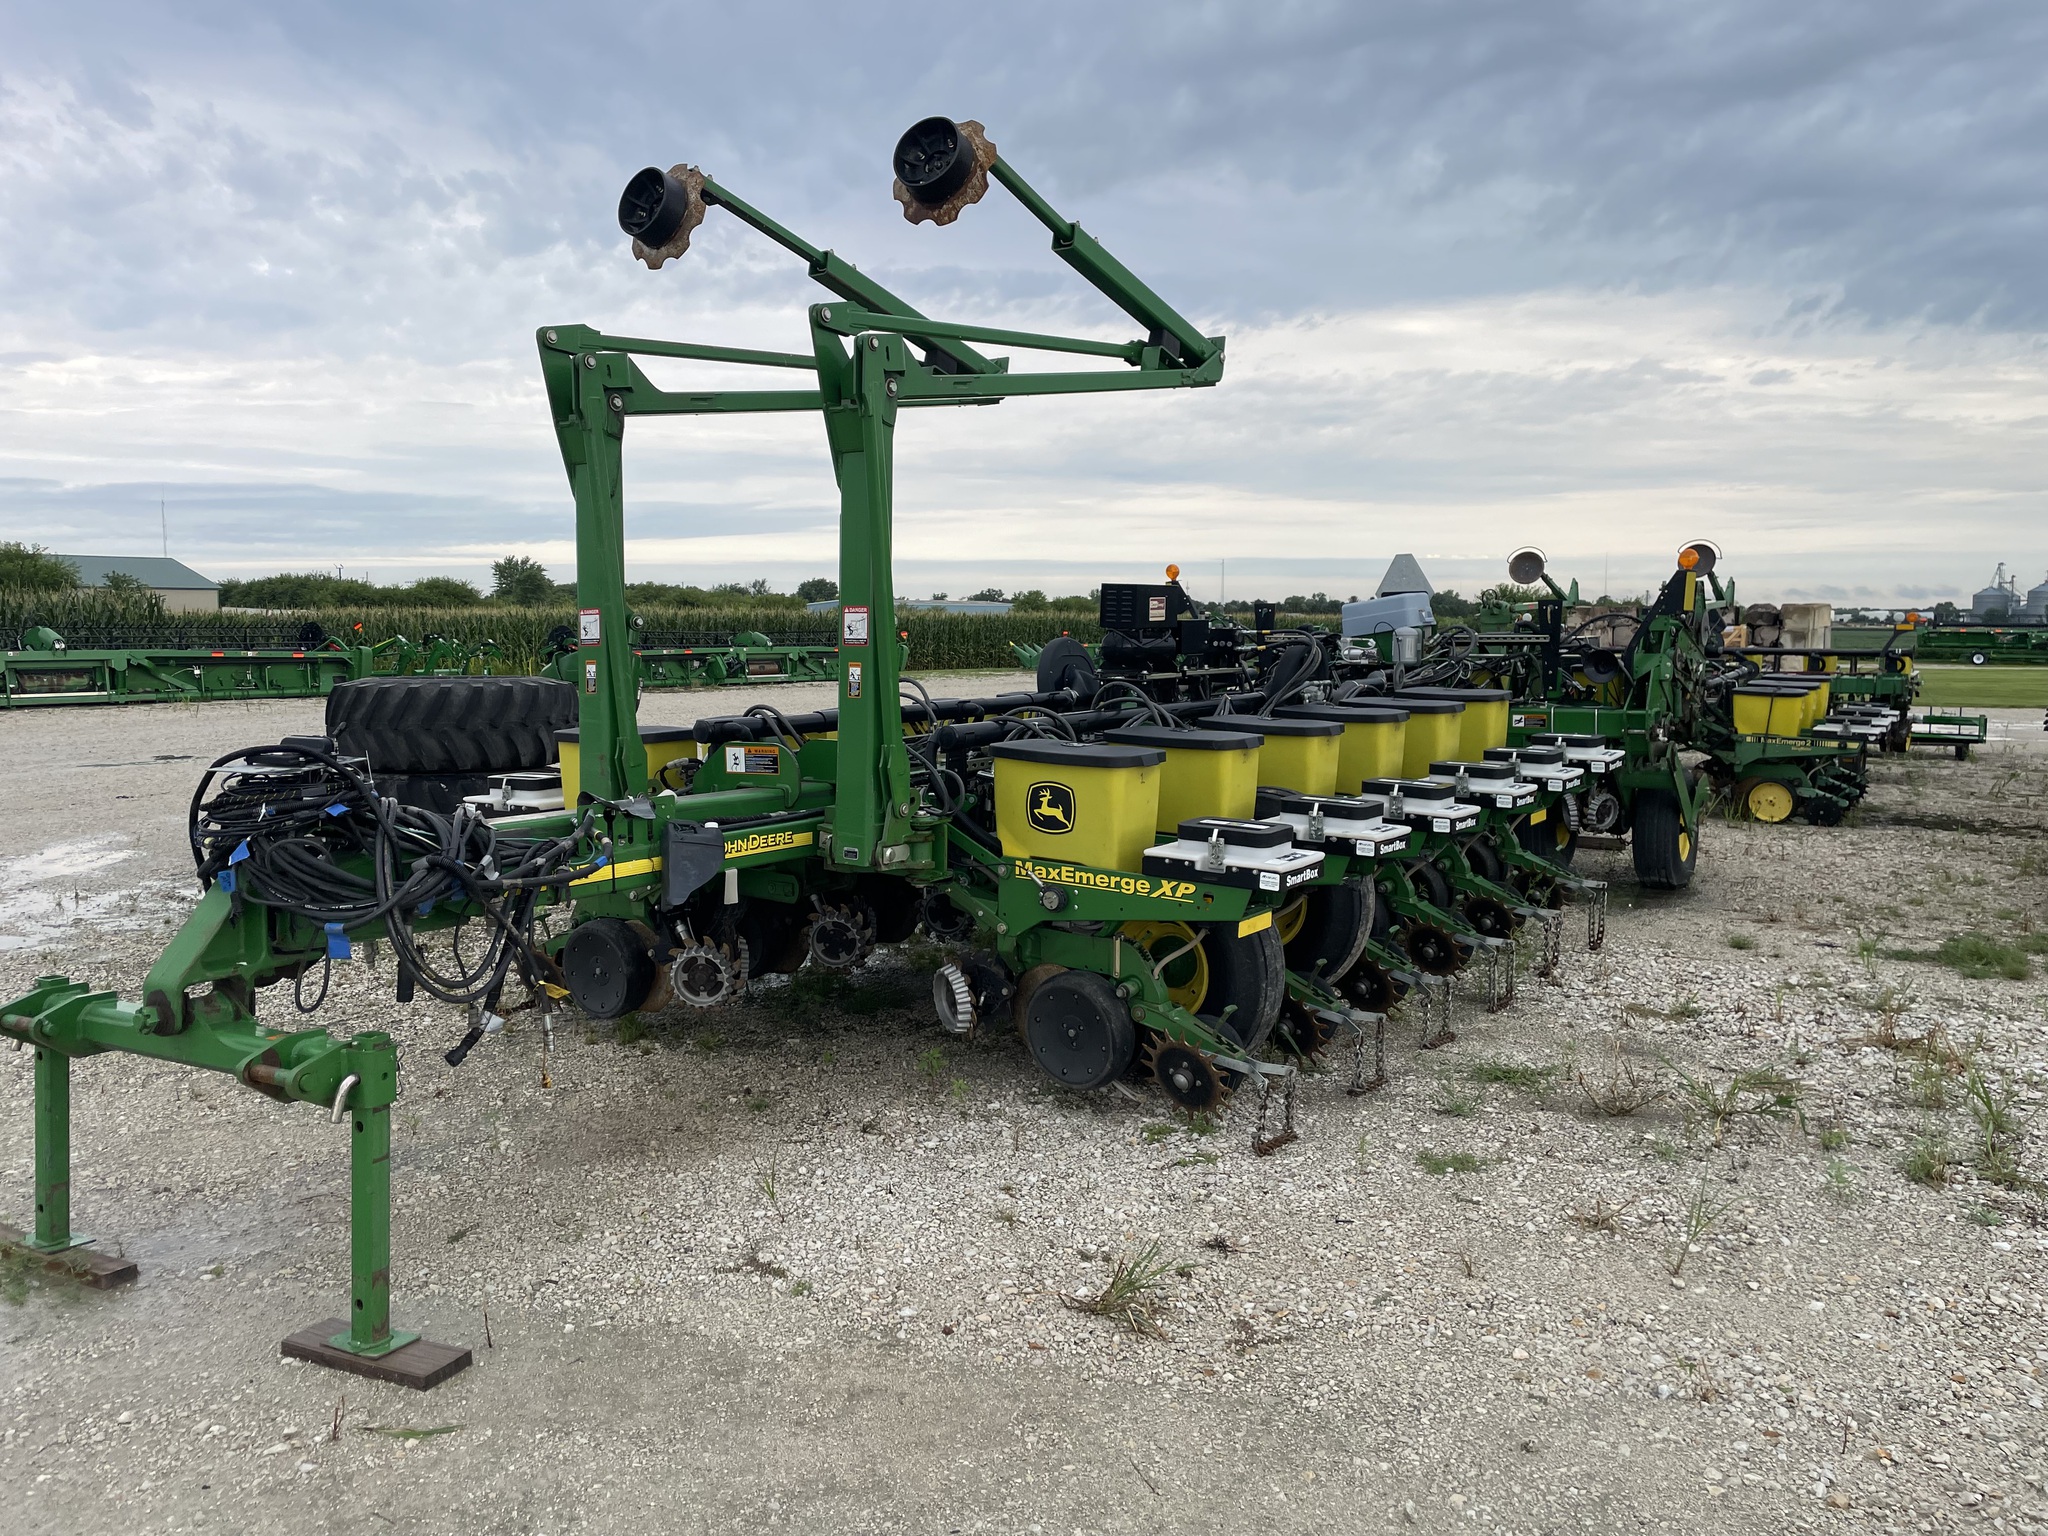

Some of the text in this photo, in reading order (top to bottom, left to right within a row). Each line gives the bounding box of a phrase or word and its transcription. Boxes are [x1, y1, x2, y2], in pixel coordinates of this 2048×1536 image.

[749, 831, 793, 849] DEERE
[1015, 860, 1197, 898] MaxEmerge XP
[1286, 867, 1319, 887] SmartBox
